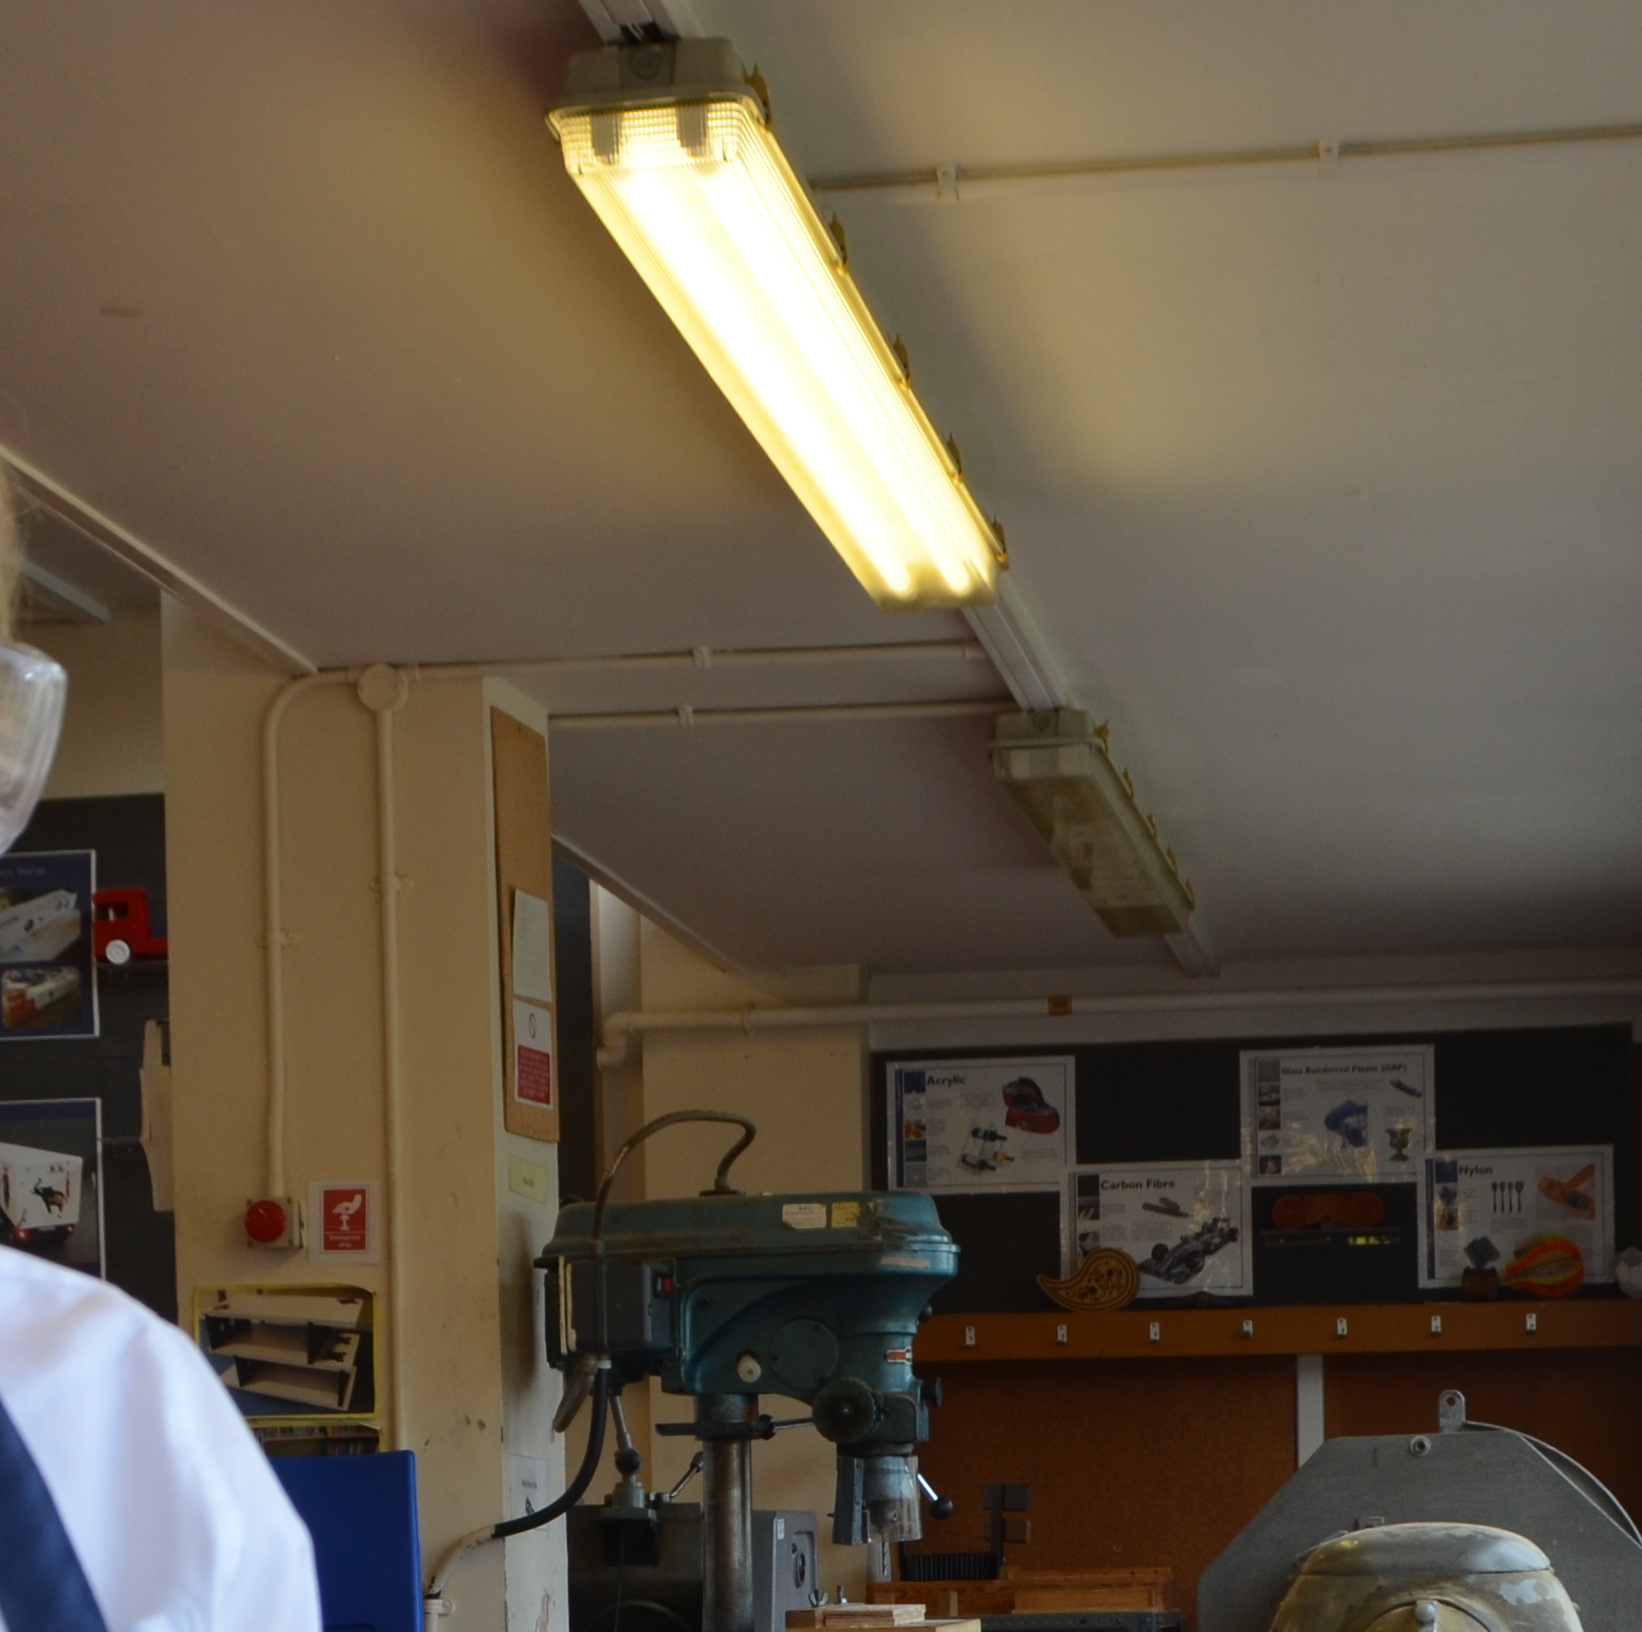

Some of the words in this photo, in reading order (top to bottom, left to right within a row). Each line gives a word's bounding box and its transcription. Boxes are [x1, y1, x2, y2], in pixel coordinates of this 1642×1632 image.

[926, 1074, 966, 1087] Acrylic
[1458, 1165, 1493, 1178] Nylon
[1100, 1180, 1143, 1190] Carbon
[1146, 1178, 1176, 1189] Fibre
